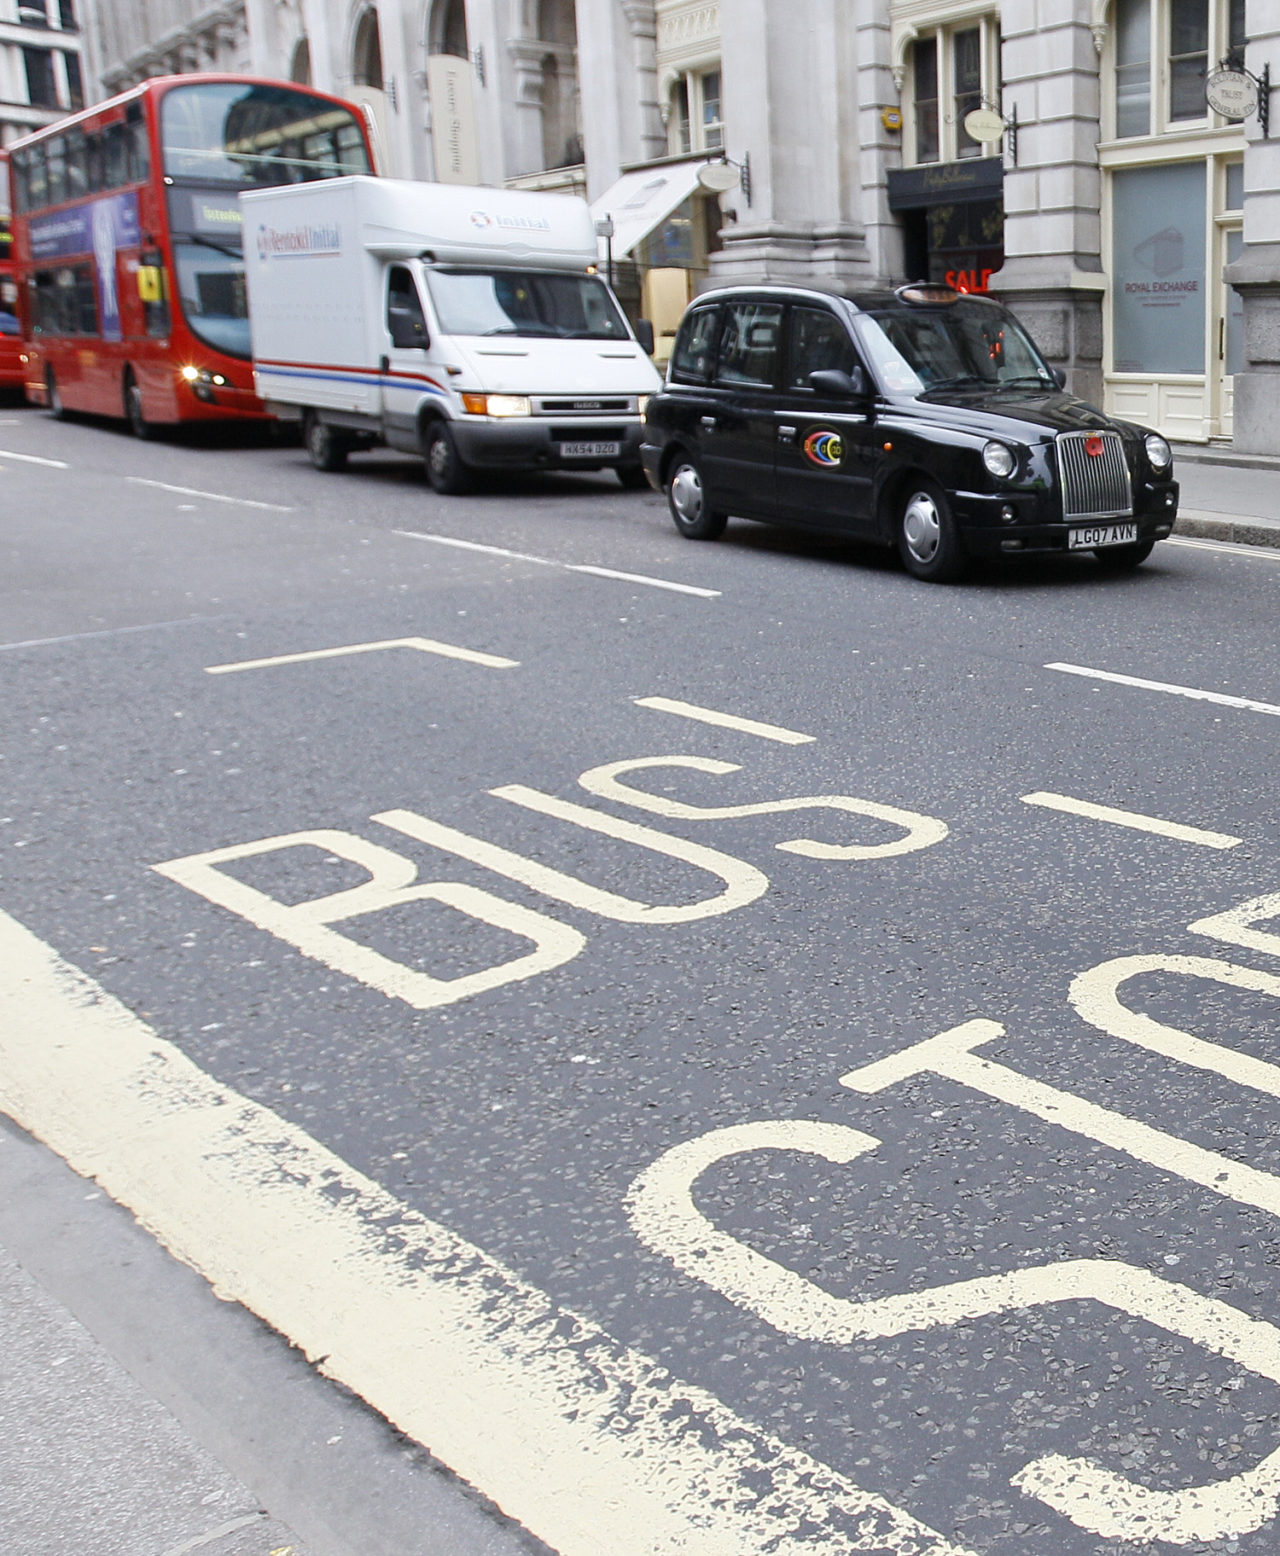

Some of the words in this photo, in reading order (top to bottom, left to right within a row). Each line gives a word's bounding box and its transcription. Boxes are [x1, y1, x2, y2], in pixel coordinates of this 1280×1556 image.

[1125, 282, 1151, 293] ROYAL
[1152, 281, 1199, 292] EXCHANGE
[1075, 527, 1108, 545] LG07
[1111, 523, 1133, 541] AVN
[150, 754, 950, 1009] BUS
